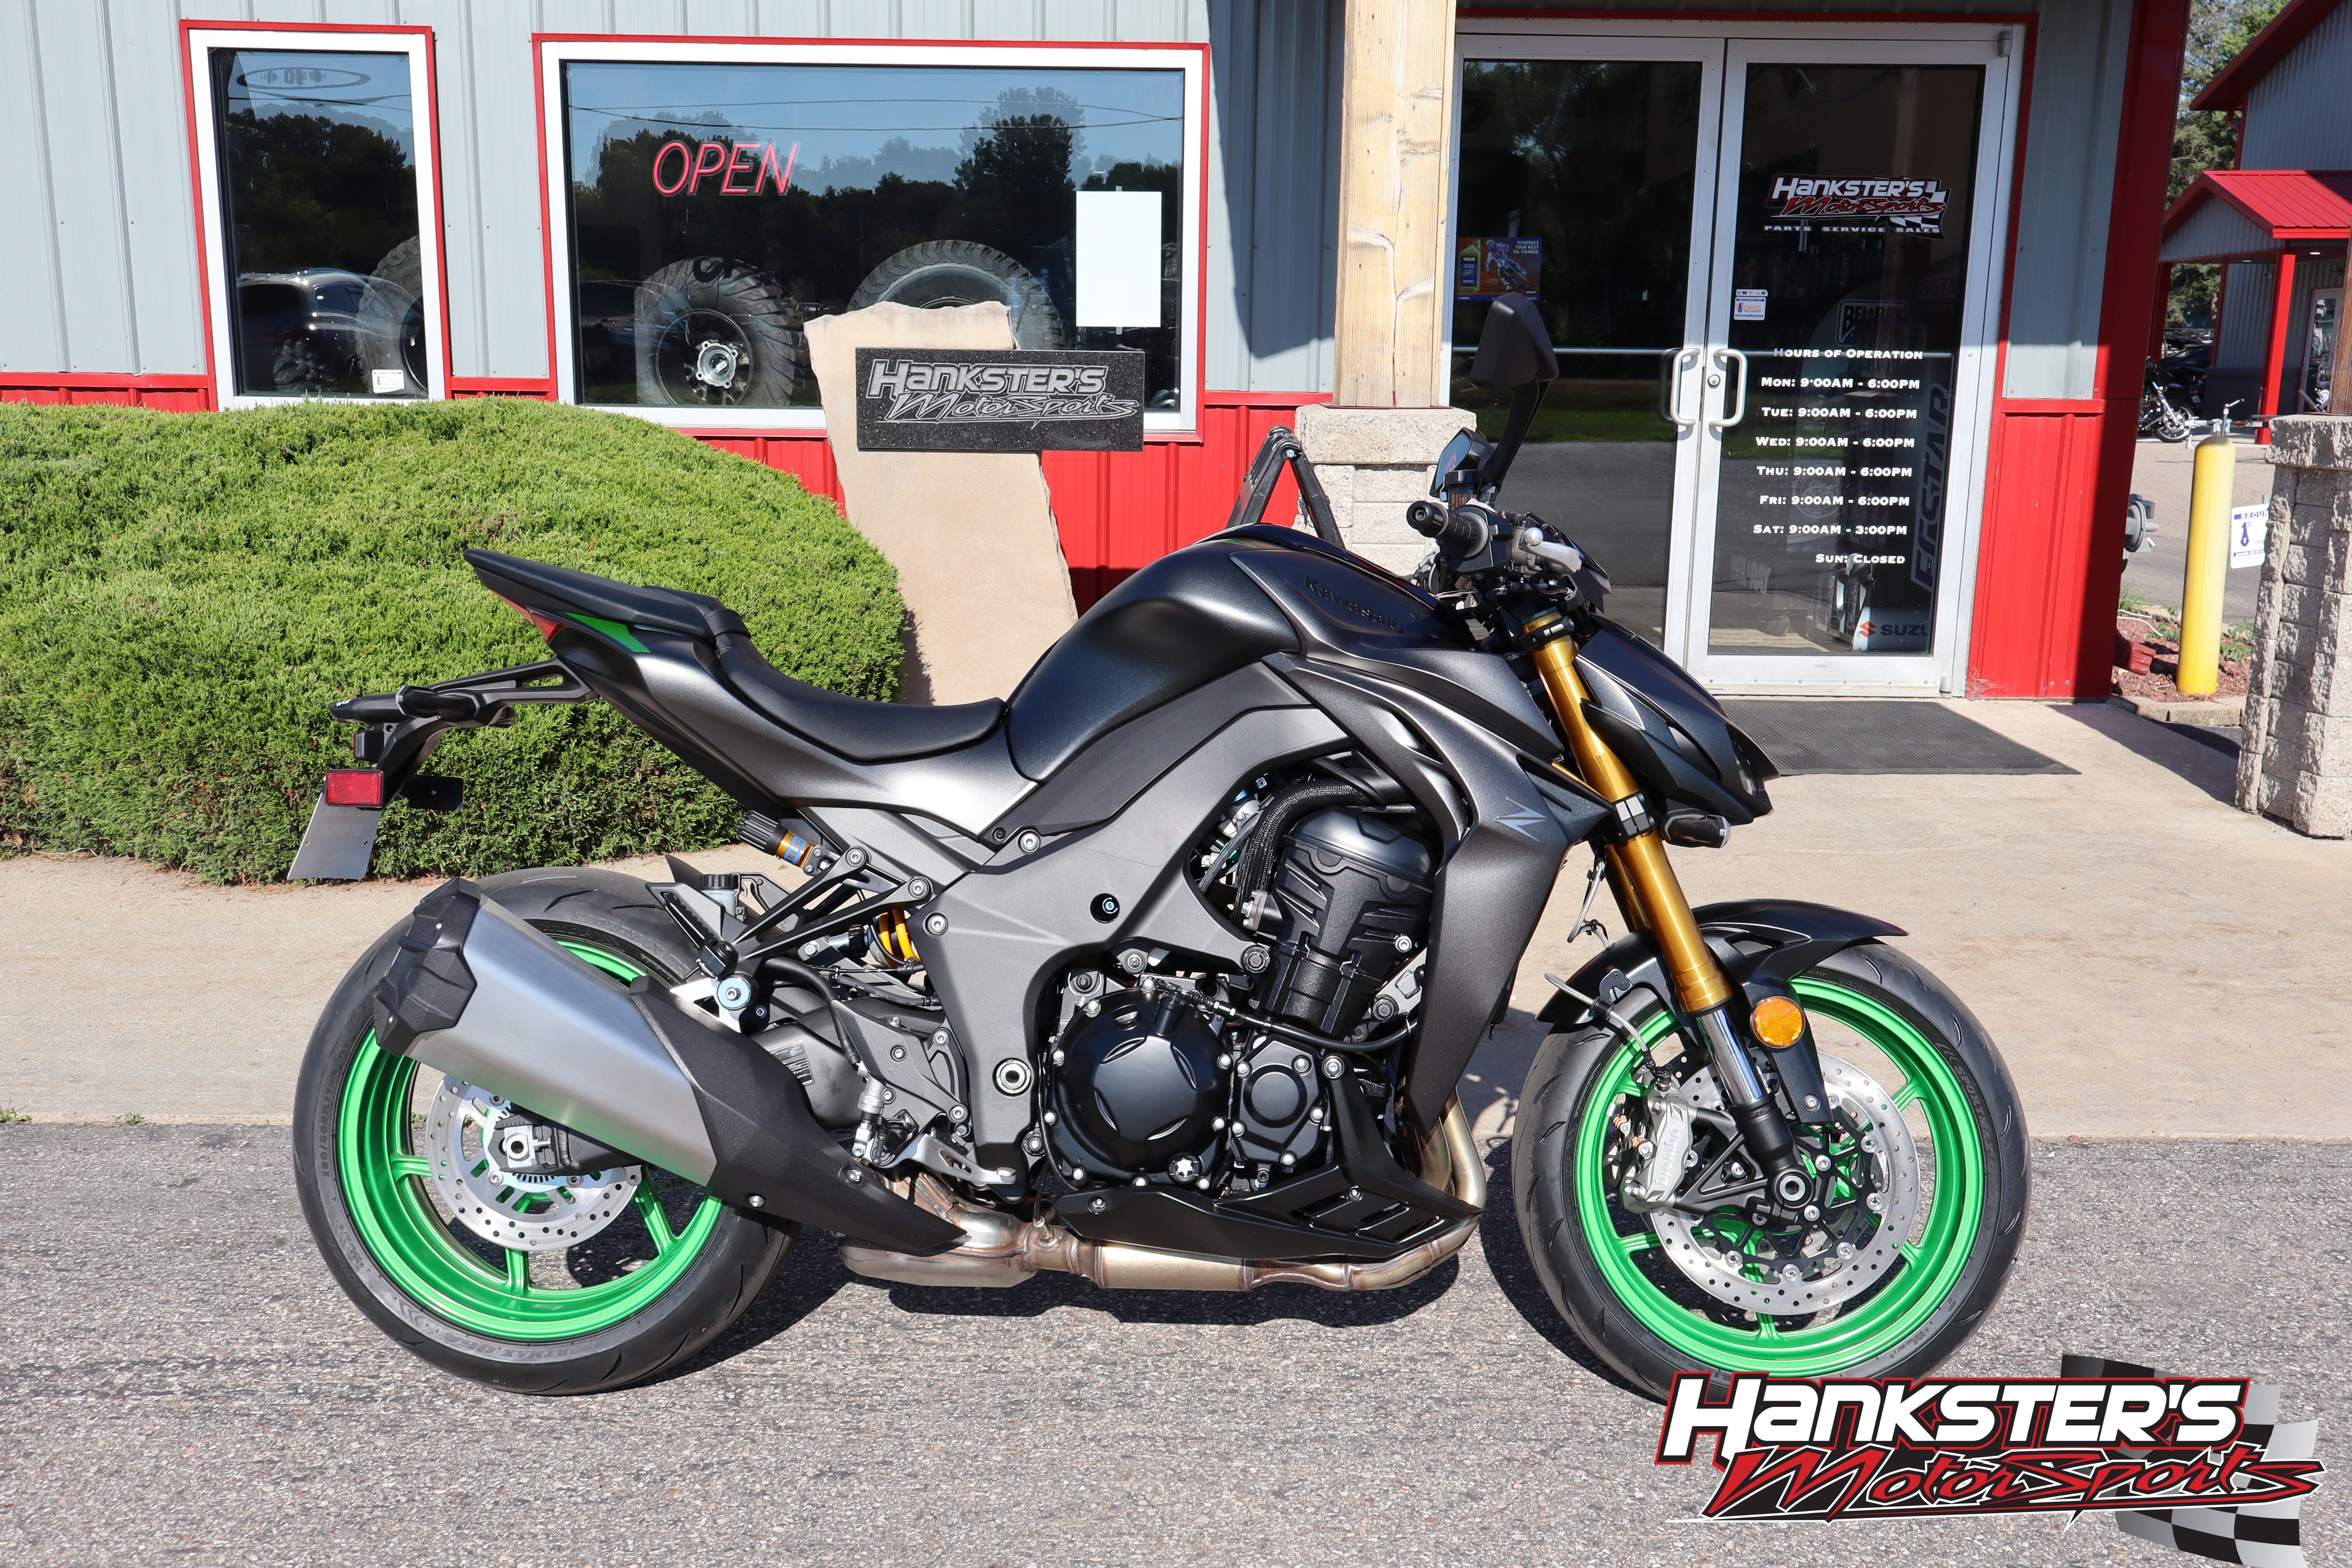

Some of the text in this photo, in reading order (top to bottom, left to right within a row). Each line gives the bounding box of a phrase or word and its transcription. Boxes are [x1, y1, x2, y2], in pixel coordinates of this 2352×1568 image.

[653, 142, 798, 194] OPEN
[1868, 379, 1920, 389] 6:00PM
[1798, 408, 1851, 417] 9:00AM
[1865, 408, 1917, 419] 6:00PM
[1796, 437, 1848, 447] 9:00AM
[1863, 438, 1915, 448] 6:00PM
[1793, 466, 1846, 476] 9:00AM
[1860, 467, 1912, 477] 6:00PM
[1791, 496, 1844, 506] 9:00AM
[1858, 496, 1910, 506] 6:00PM
[1789, 525, 1841, 535] 9:00AM
[1855, 526, 1907, 535] 3:00PM
[1303, 574, 1405, 634] Kawasaki
[1955, 1065, 1994, 1152] SPORTMAX
[1654, 1127, 1680, 1187] brembo
